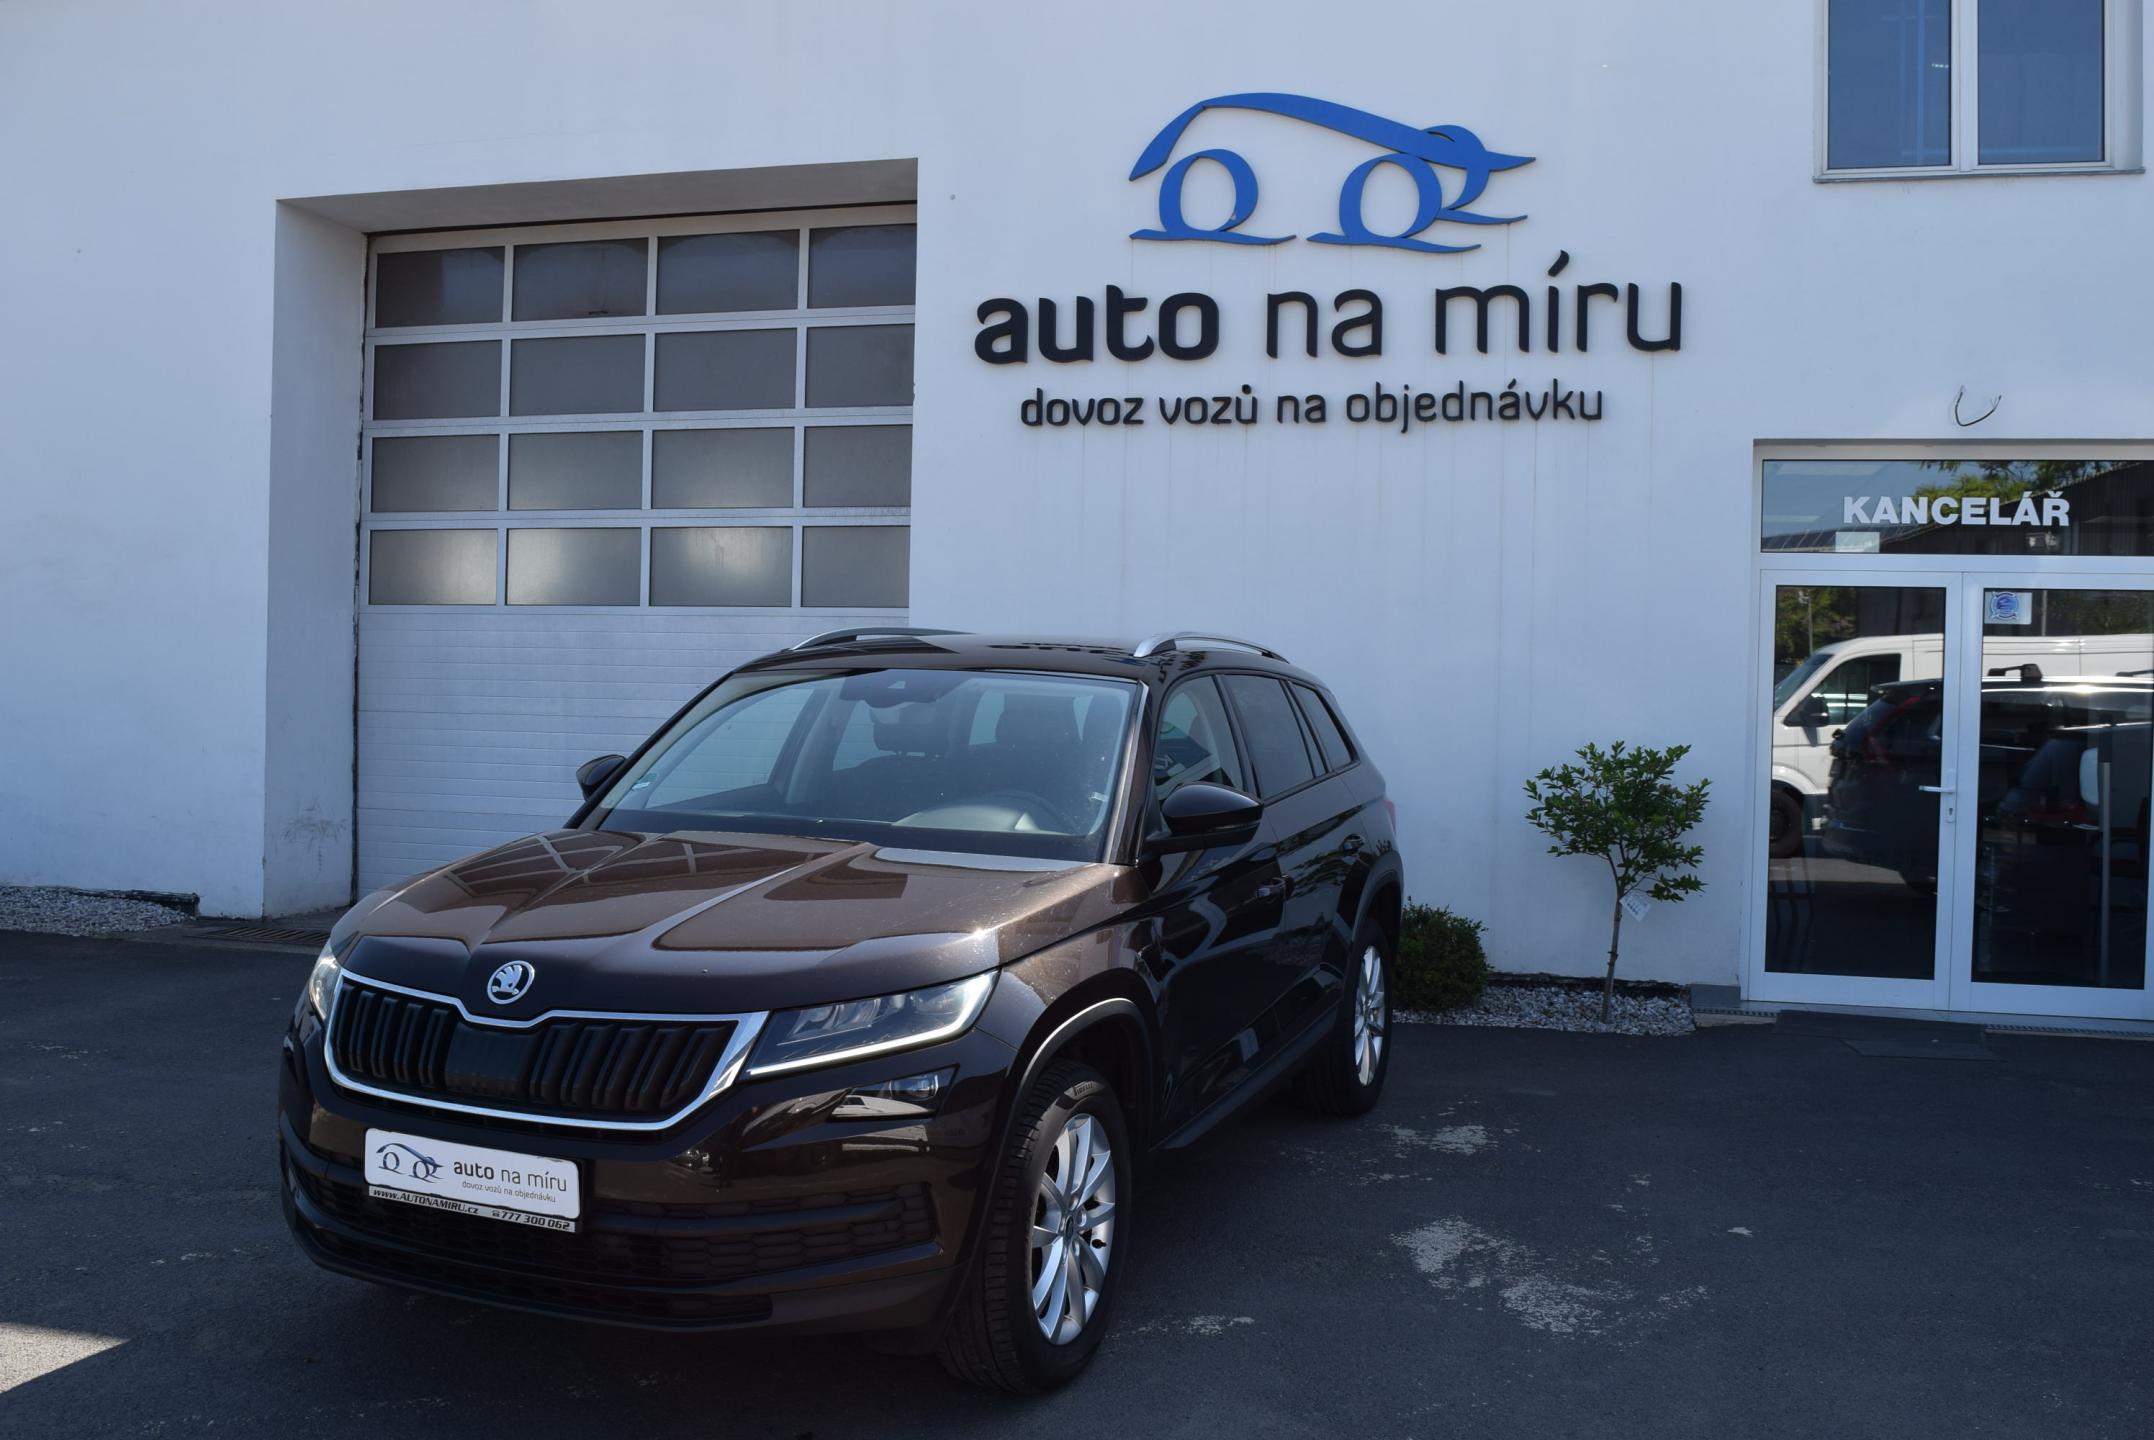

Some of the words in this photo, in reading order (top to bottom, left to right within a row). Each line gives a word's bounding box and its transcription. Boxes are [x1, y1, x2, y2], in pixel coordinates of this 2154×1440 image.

[974, 284, 1220, 365] auto
[1266, 289, 1384, 360] na
[1434, 249, 1683, 356] míru
[1020, 387, 1145, 428] dovoz
[1158, 383, 1259, 426] vozů
[1276, 394, 1327, 425] na
[1345, 378, 1603, 435] objednávku
[1843, 490, 2071, 526] KANCELÁŘ
[453, 1160, 495, 1180] auto
[501, 1168, 521, 1185] na
[527, 1171, 567, 1192] míru
[462, 1180, 483, 1191] dovoz
[485, 1184, 502, 1194] vozů
[504, 1188, 513, 1196] na
[514, 1188, 556, 1203] objednávku
[373, 1189, 479, 1215] www.AUTONAMIRU.cz
[501, 1210, 522, 1222] 777
[523, 1214, 546, 1226] 300
[547, 1218, 571, 1231] 062
